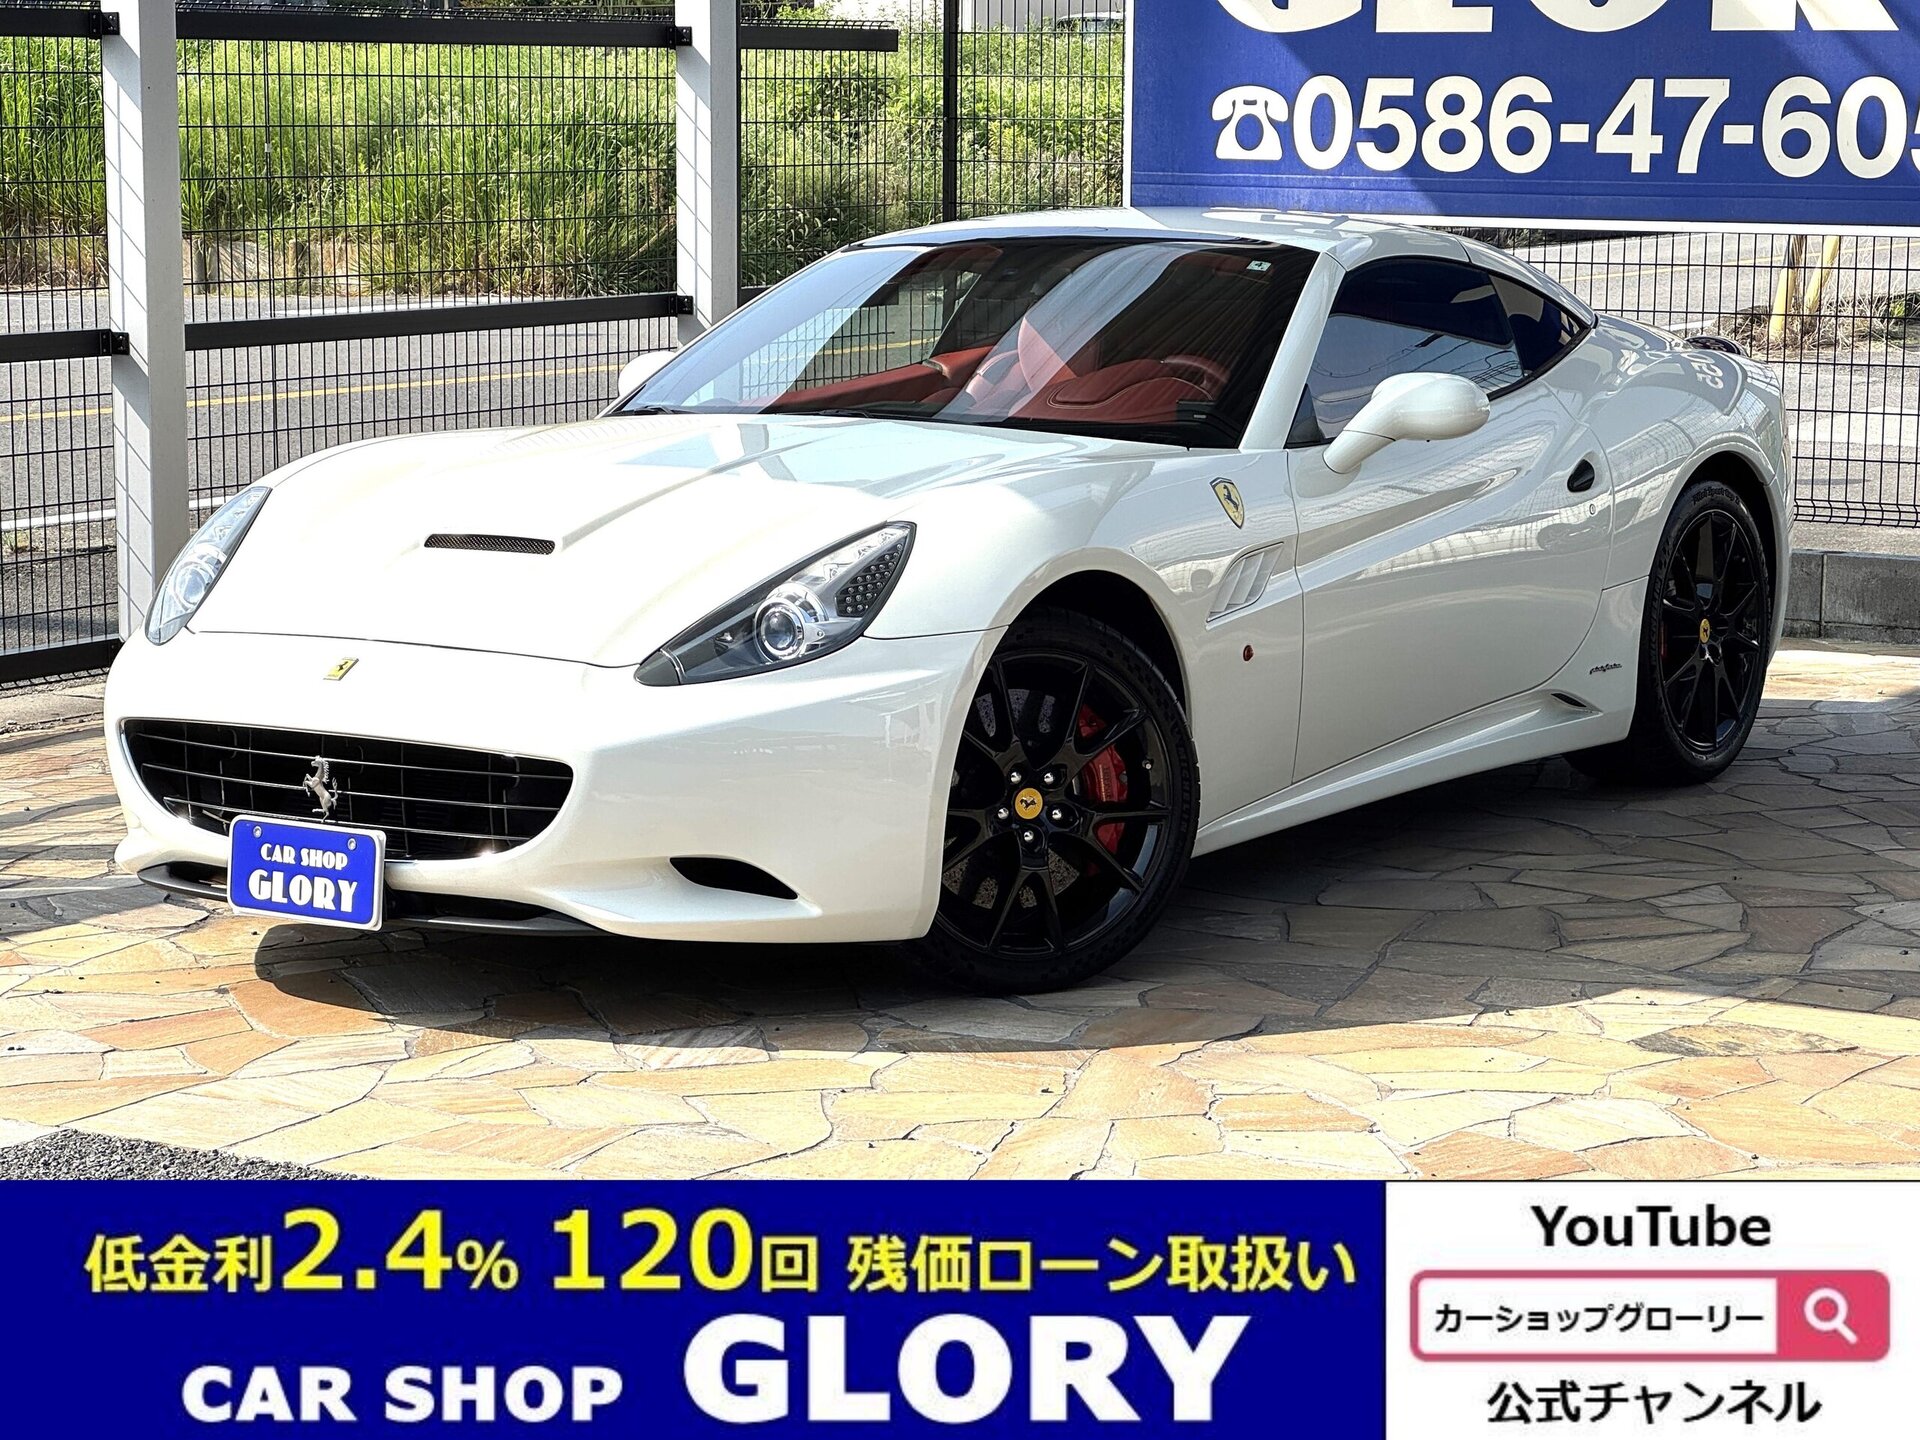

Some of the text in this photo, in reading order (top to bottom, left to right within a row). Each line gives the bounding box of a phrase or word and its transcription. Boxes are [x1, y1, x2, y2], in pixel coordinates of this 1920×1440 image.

[1292, 75, 1920, 179] 0586-47-60
[260, 843, 348, 871] CAR SHOP
[248, 869, 358, 913] GLORY
